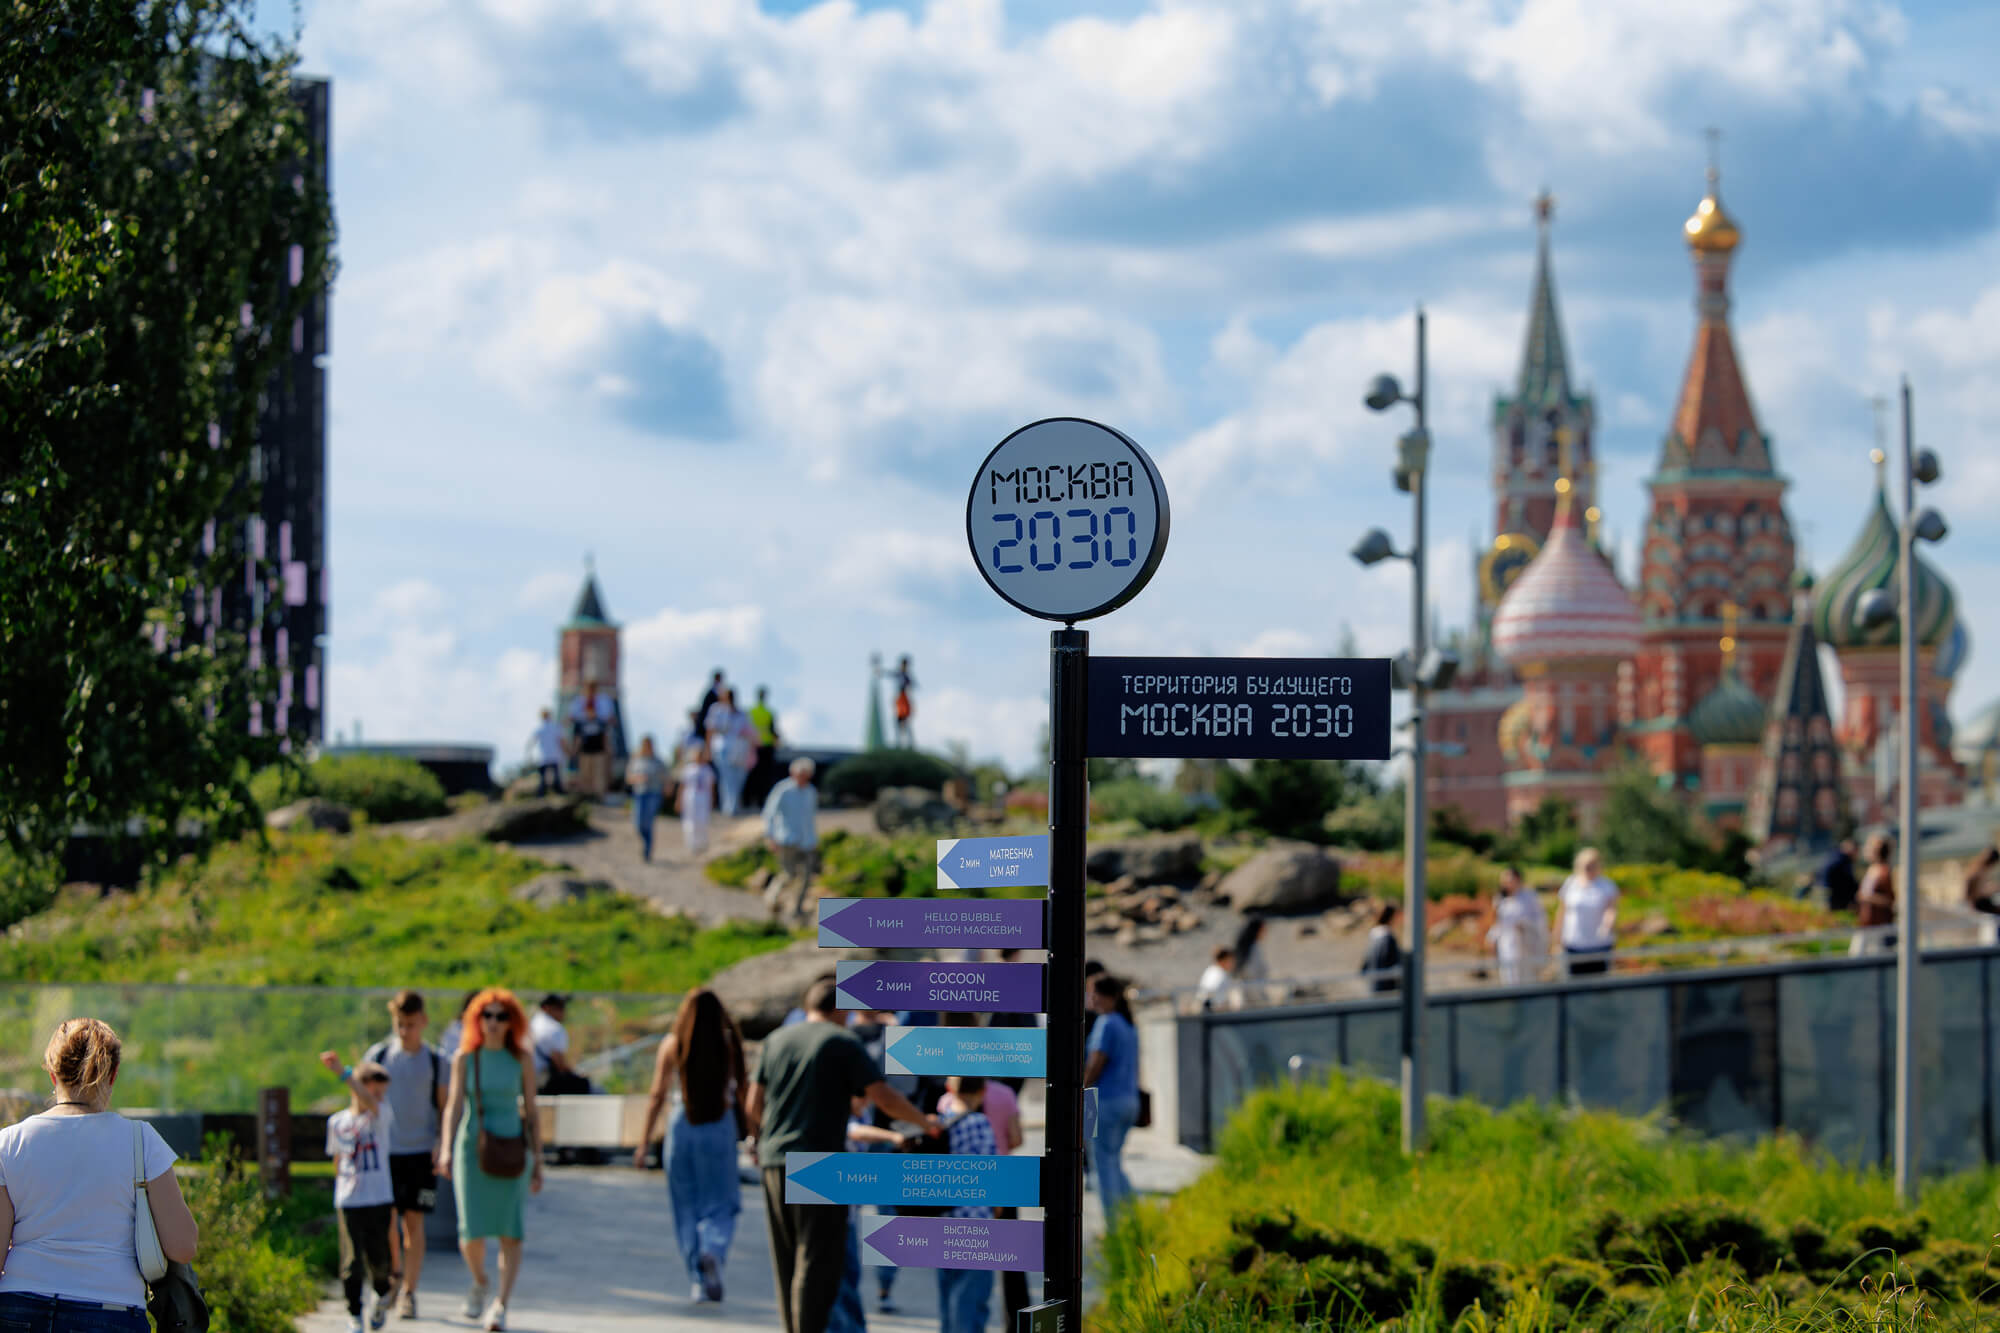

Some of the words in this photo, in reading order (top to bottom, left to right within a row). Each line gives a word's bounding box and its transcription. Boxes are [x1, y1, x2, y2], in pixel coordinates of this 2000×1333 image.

[991, 461, 1134, 505] МОСКВА
[992, 506, 1137, 573] 2030
[1122, 675, 1237, 695] ТЕРРИТОРИЯ
[1247, 676, 1352, 698] БУДУЩЕГО
[1120, 703, 1253, 737] МОСКВА
[1271, 704, 1353, 738] 2030
[989, 847, 1034, 860] MATRESHKA
[960, 858, 966, 869] 2
[965, 858, 981, 868] мин
[989, 866, 1004, 878] LYM
[1005, 865, 1019, 877] ART
[867, 917, 873, 928] 1
[876, 919, 904, 928] мин
[924, 912, 958, 922] HELLO
[960, 912, 1002, 922] BUBBLE
[924, 925, 961, 935] АНТОН
[963, 925, 1022, 935] МАСКЕВИЧ
[929, 972, 985, 985] COCOON
[876, 980, 883, 991] 2
[886, 982, 911, 991] мин
[929, 990, 1000, 1002] SIGNATURE
[916, 1045, 923, 1056] 2
[924, 1047, 944, 1057] мин
[957, 1053, 1004, 1063] КУЛЬТУРНЫЙ
[902, 1159, 934, 1170] СВЕТ
[937, 1158, 997, 1171] РУССКОЙ
[837, 1170, 843, 1183] 1
[847, 1172, 878, 1183] мин
[902, 1174, 979, 1185] ЖИВОПИСИ
[902, 1188, 987, 1199] DREAMLASER
[943, 1225, 990, 1236] ВЫСТАВКА
[897, 1234, 905, 1246] 3
[906, 1236, 928, 1247] мин
[943, 1238, 989, 1249] «НАХОДКИ
[943, 1250, 950, 1260] В
[951, 1251, 1018, 1263] РЕСТАВРАЦИИ»
